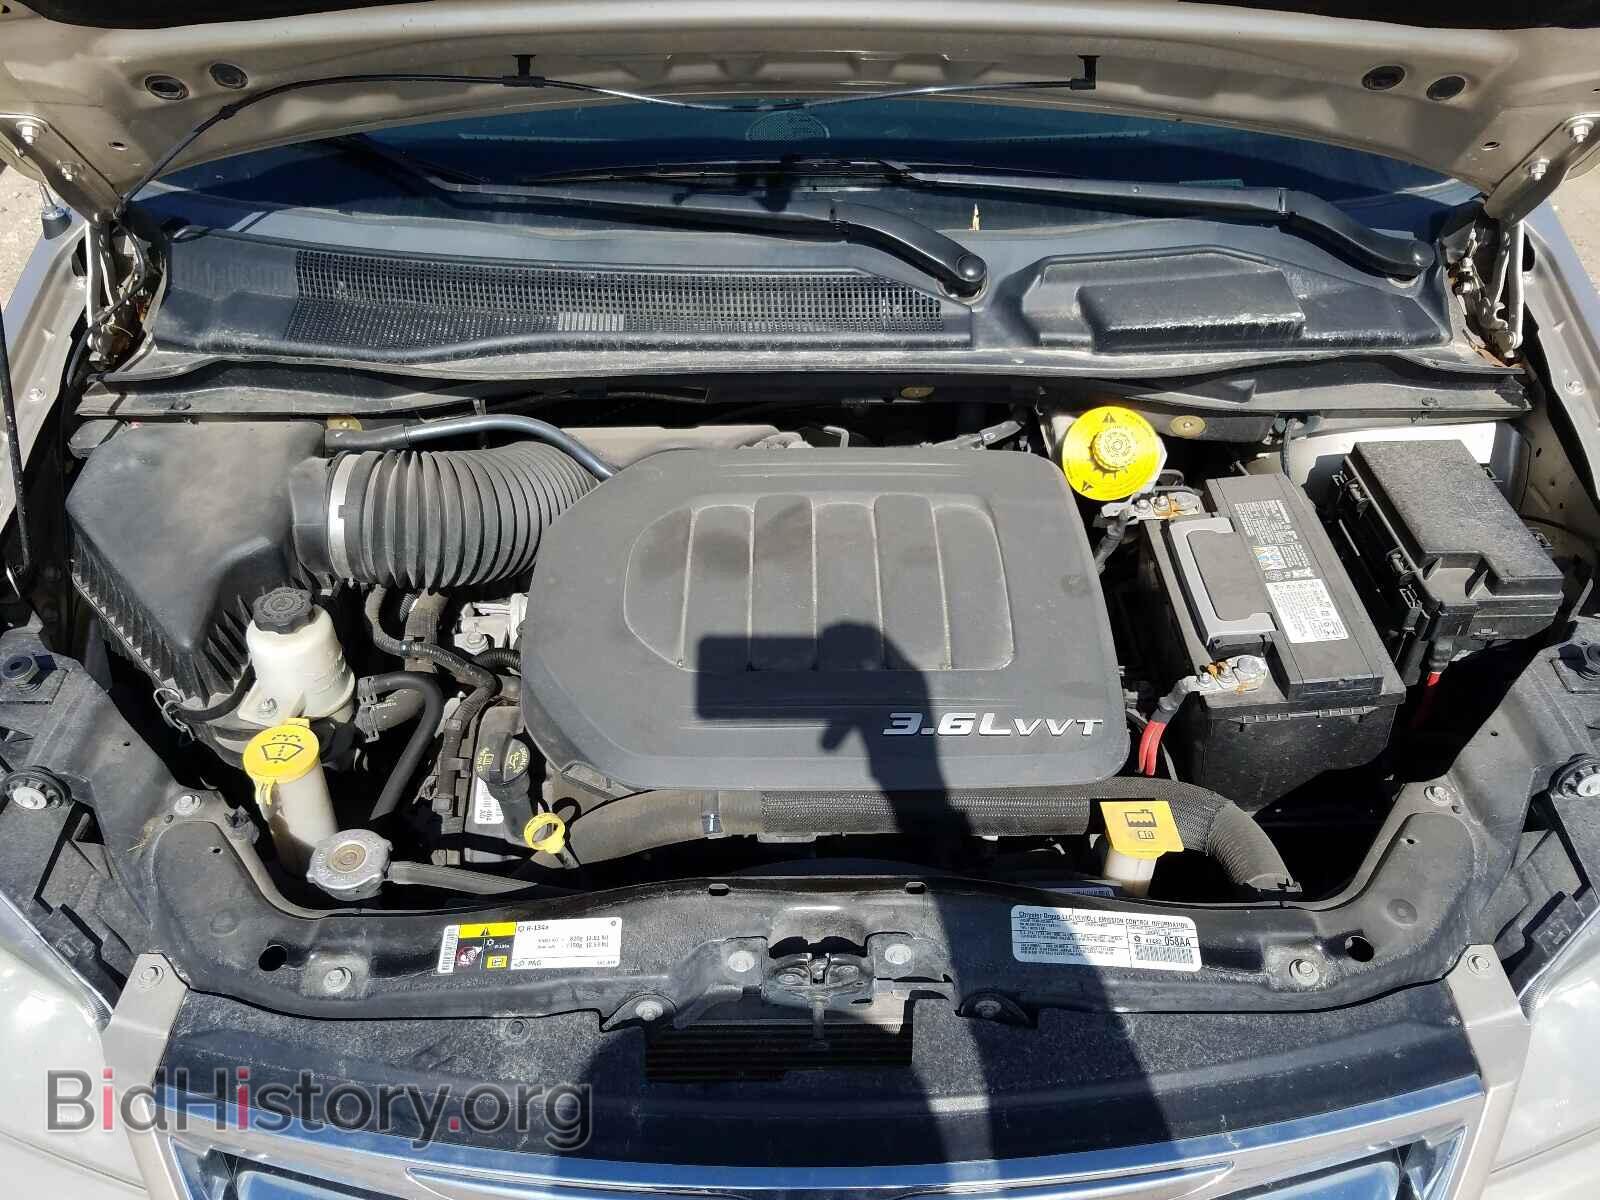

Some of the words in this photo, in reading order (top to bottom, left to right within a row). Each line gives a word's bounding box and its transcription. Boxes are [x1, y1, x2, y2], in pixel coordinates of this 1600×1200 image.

[882, 712, 1011, 736] 3.6L
[1013, 718, 1104, 736] VVT
[1164, 936, 1191, 947] 058AA
